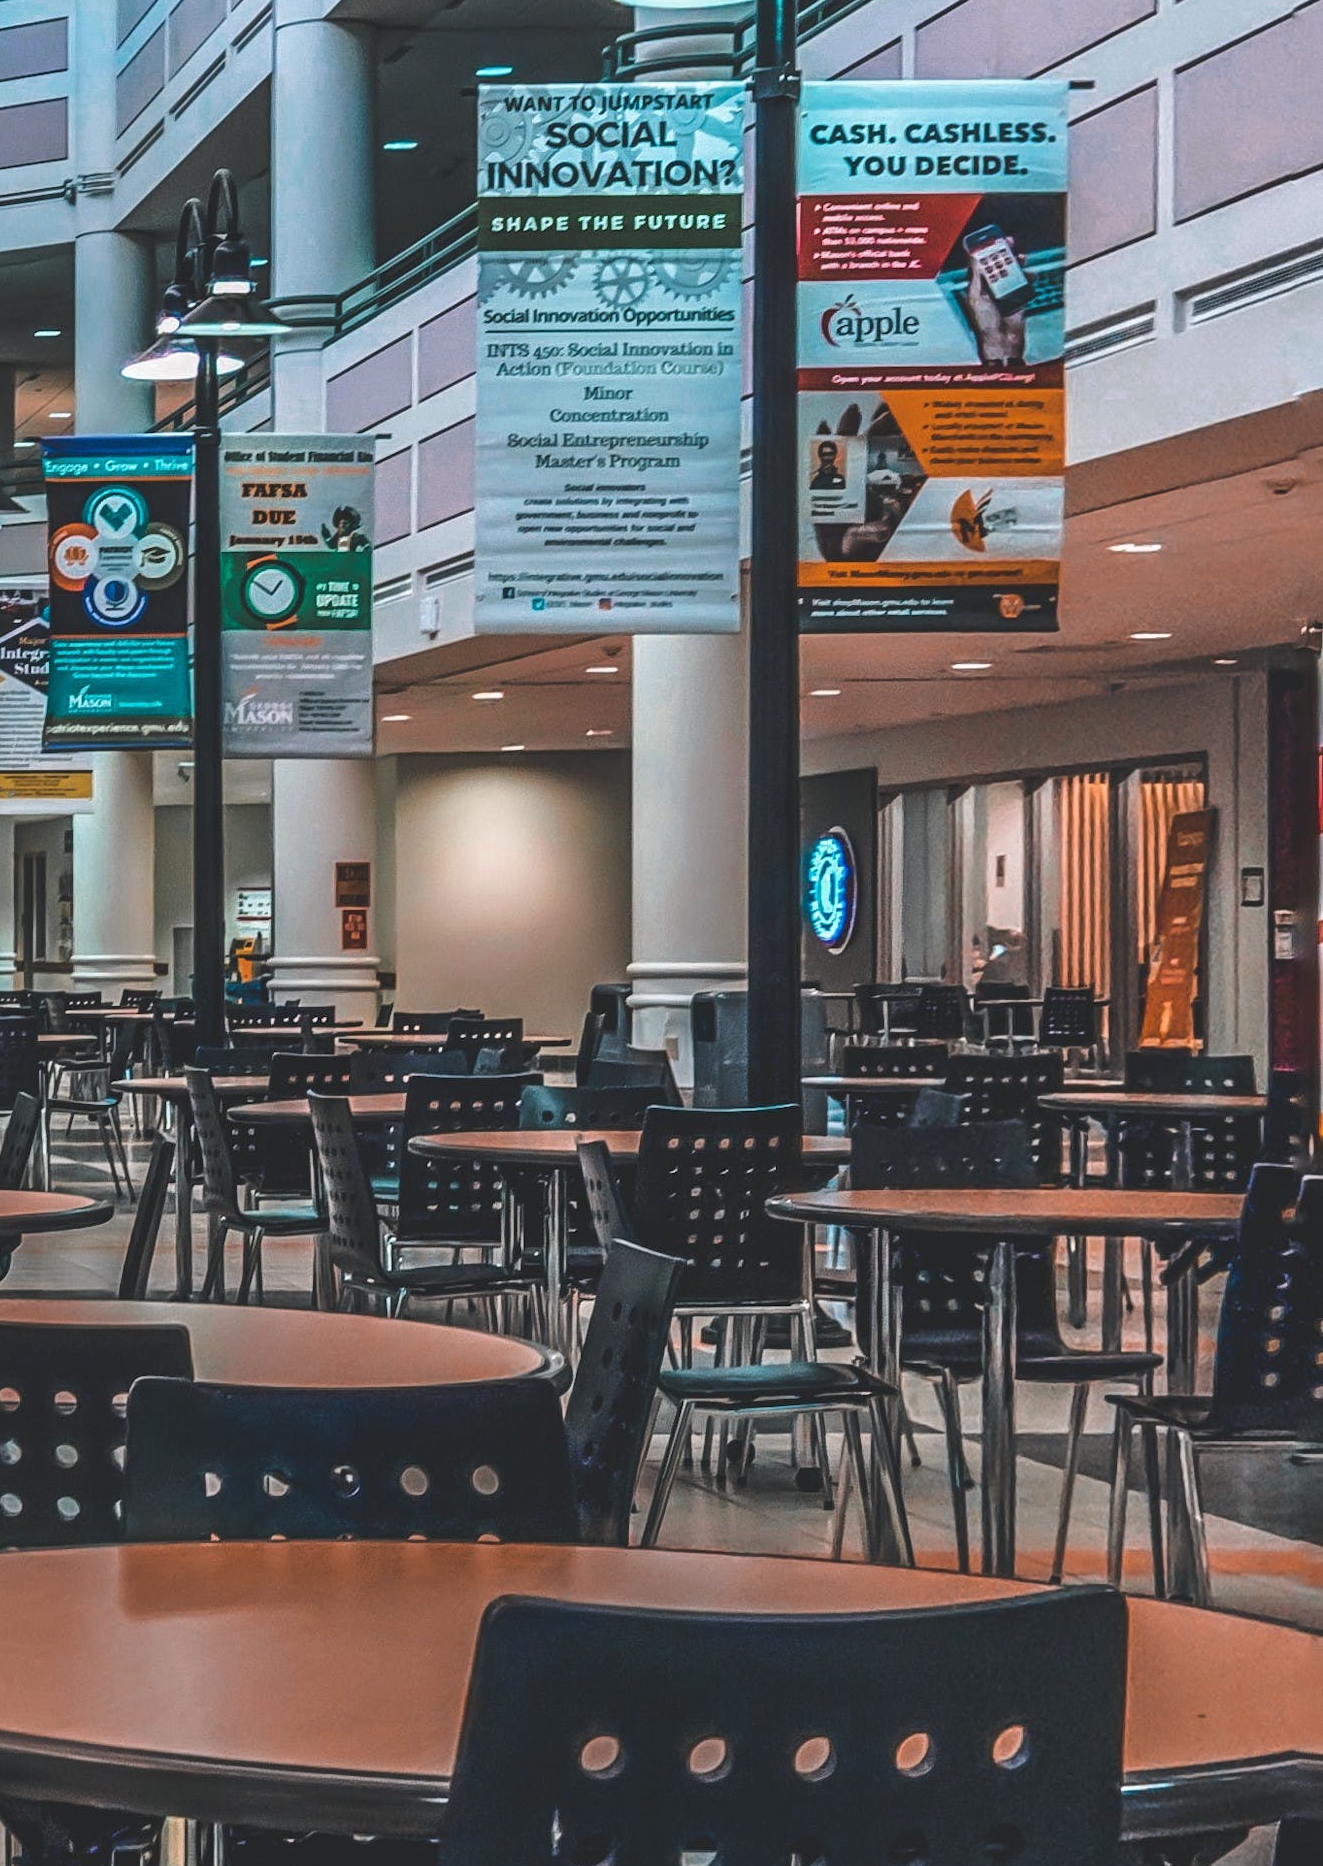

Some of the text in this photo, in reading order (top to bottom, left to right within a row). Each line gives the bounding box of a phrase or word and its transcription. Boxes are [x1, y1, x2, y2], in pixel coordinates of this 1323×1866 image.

[505, 93, 714, 114] WANT TO JUMPSTART
[546, 120, 677, 147] SOCIAL
[810, 122, 1056, 144] CASH. CASHLESS.
[487, 160, 736, 188] INNOVATION?
[844, 155, 1028, 176] YOU DECIDE.
[491, 214, 727, 232] SHAPE THE FUTURE
[484, 307, 735, 326] Social Innovation Opportunities
[836, 307, 919, 342] apple
[487, 341, 734, 360] INTS 450: Social Innovation in
[496, 360, 724, 377] Action (Foundation Course)
[583, 386, 633, 400] Minor
[550, 408, 669, 423] Concentration
[507, 432, 709, 450] Social Entrepreneurship
[256, 451, 265, 462] of
[268, 451, 305, 462] Student
[308, 451, 354, 462] Financial
[535, 453, 680, 471] Master's Program
[45, 458, 188, 475] Engage Grow Thrive
[242, 483, 308, 498] FAFSA
[564, 483, 593, 492] Social
[252, 510, 296, 525] DUE
[315, 593, 359, 608] UPDATE
[0, 646, 50, 663] Integr
[68, 695, 111, 709] MASON
[224, 702, 292, 724] MASON
